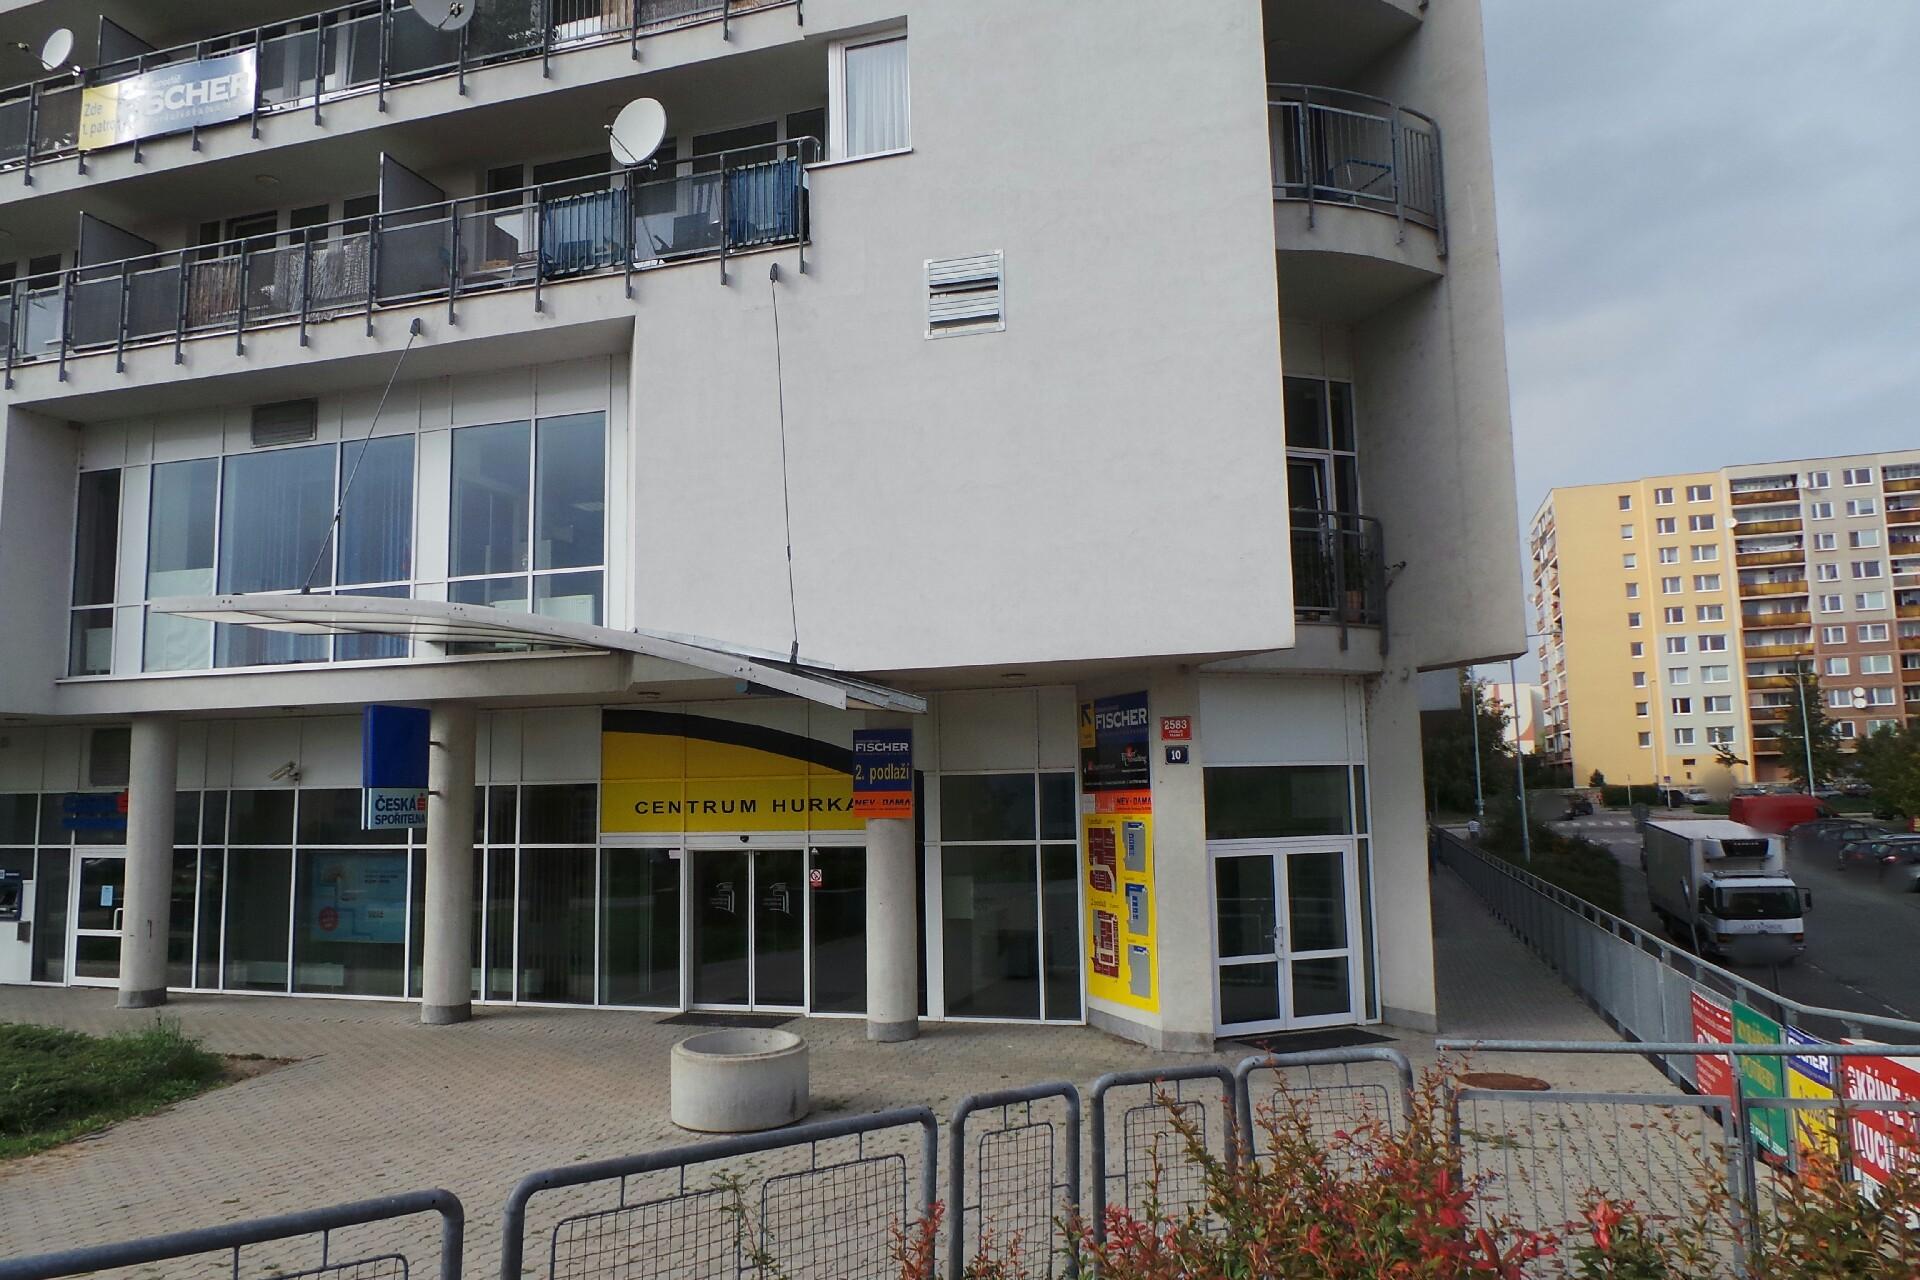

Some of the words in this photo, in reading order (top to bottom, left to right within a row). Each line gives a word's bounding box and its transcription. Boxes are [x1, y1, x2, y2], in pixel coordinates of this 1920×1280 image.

[128, 72, 249, 117] SCHER
[84, 103, 103, 117] Zde
[1095, 707, 1147, 730] FISCHER
[1164, 720, 1187, 730] 2583
[855, 742, 909, 752] FISCHER
[1171, 750, 1181, 760] 10
[855, 764, 864, 780] 2.
[869, 763, 910, 785] podlaží
[375, 793, 416, 811] ČESKÁ
[634, 799, 756, 815] CENTRUM
[375, 812, 425, 825] SPOŘITELNA
